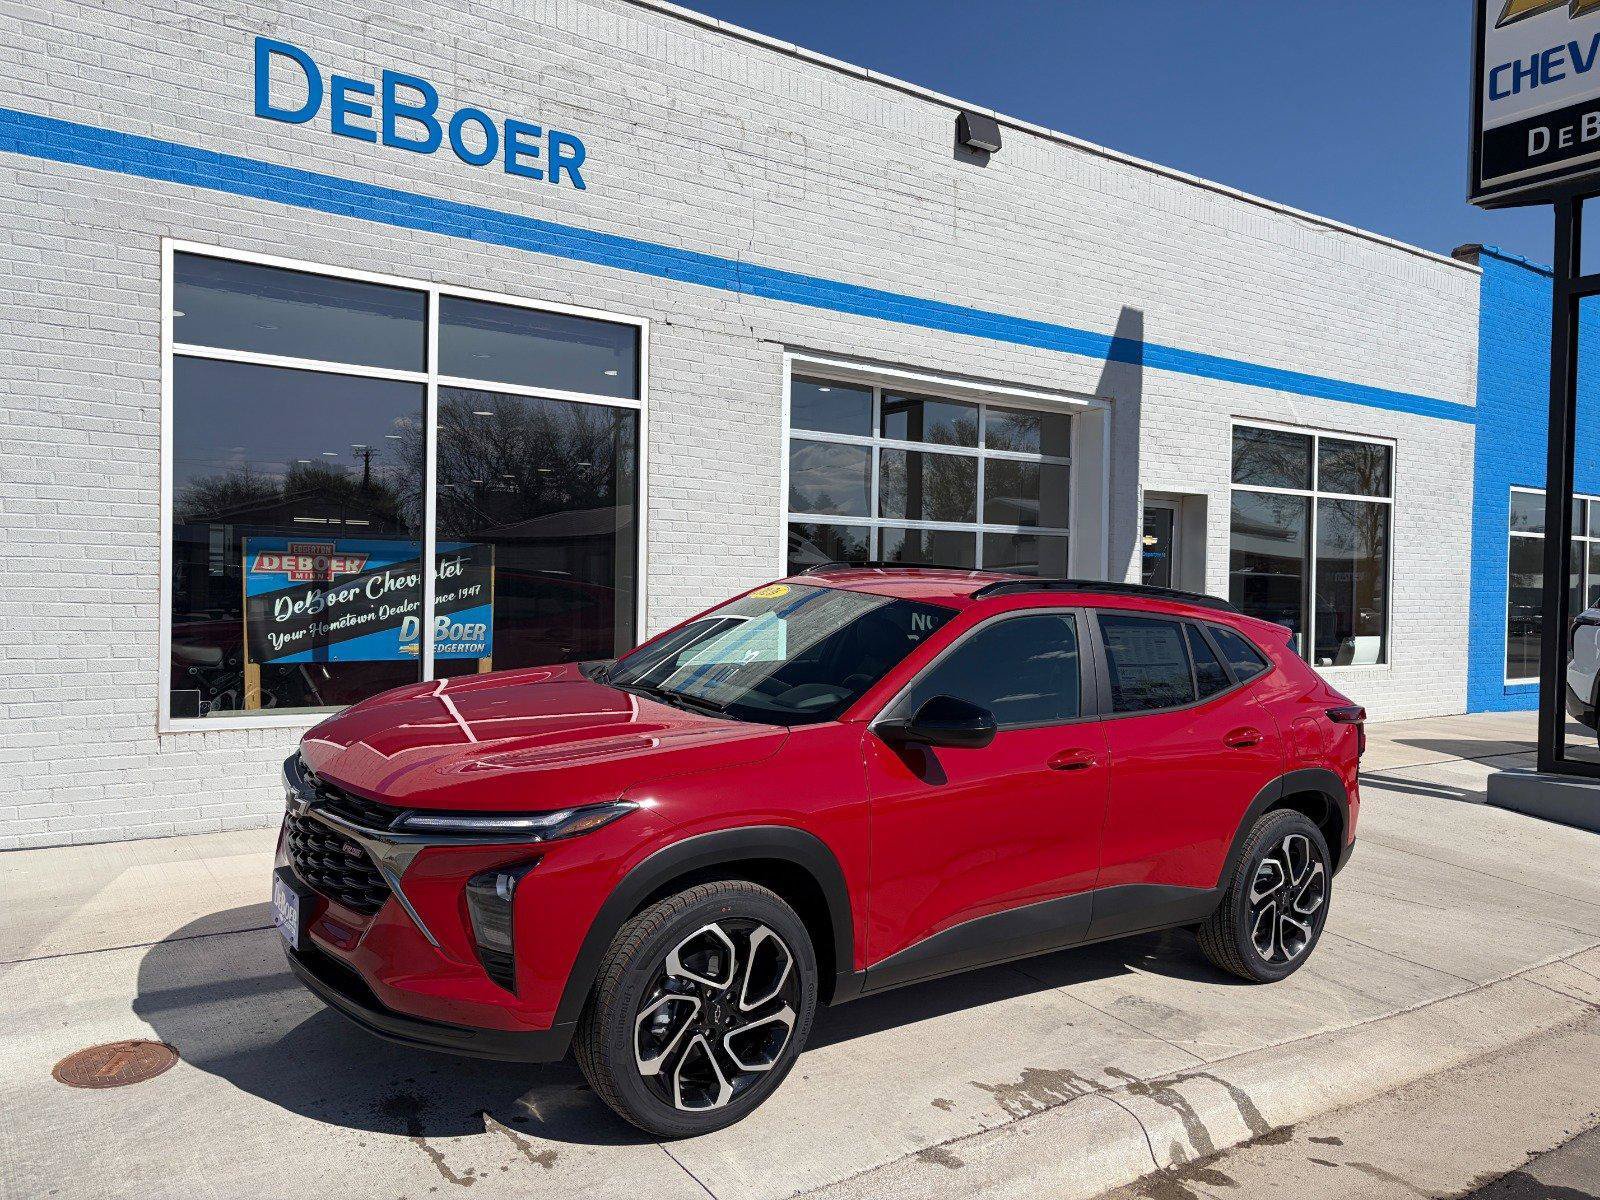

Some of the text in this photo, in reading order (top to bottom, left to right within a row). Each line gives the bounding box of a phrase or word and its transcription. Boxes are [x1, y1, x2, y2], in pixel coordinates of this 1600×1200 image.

[1489, 31, 1600, 102] CHEV
[262, 555, 361, 571] DEBOER
[274, 555, 472, 622] DeBoer Chevlet
[267, 629, 307, 651] Your
[309, 612, 377, 638] Hometown
[379, 598, 420, 620] Dealer
[458, 584, 482, 600] 1947
[399, 615, 487, 642] DBOER
